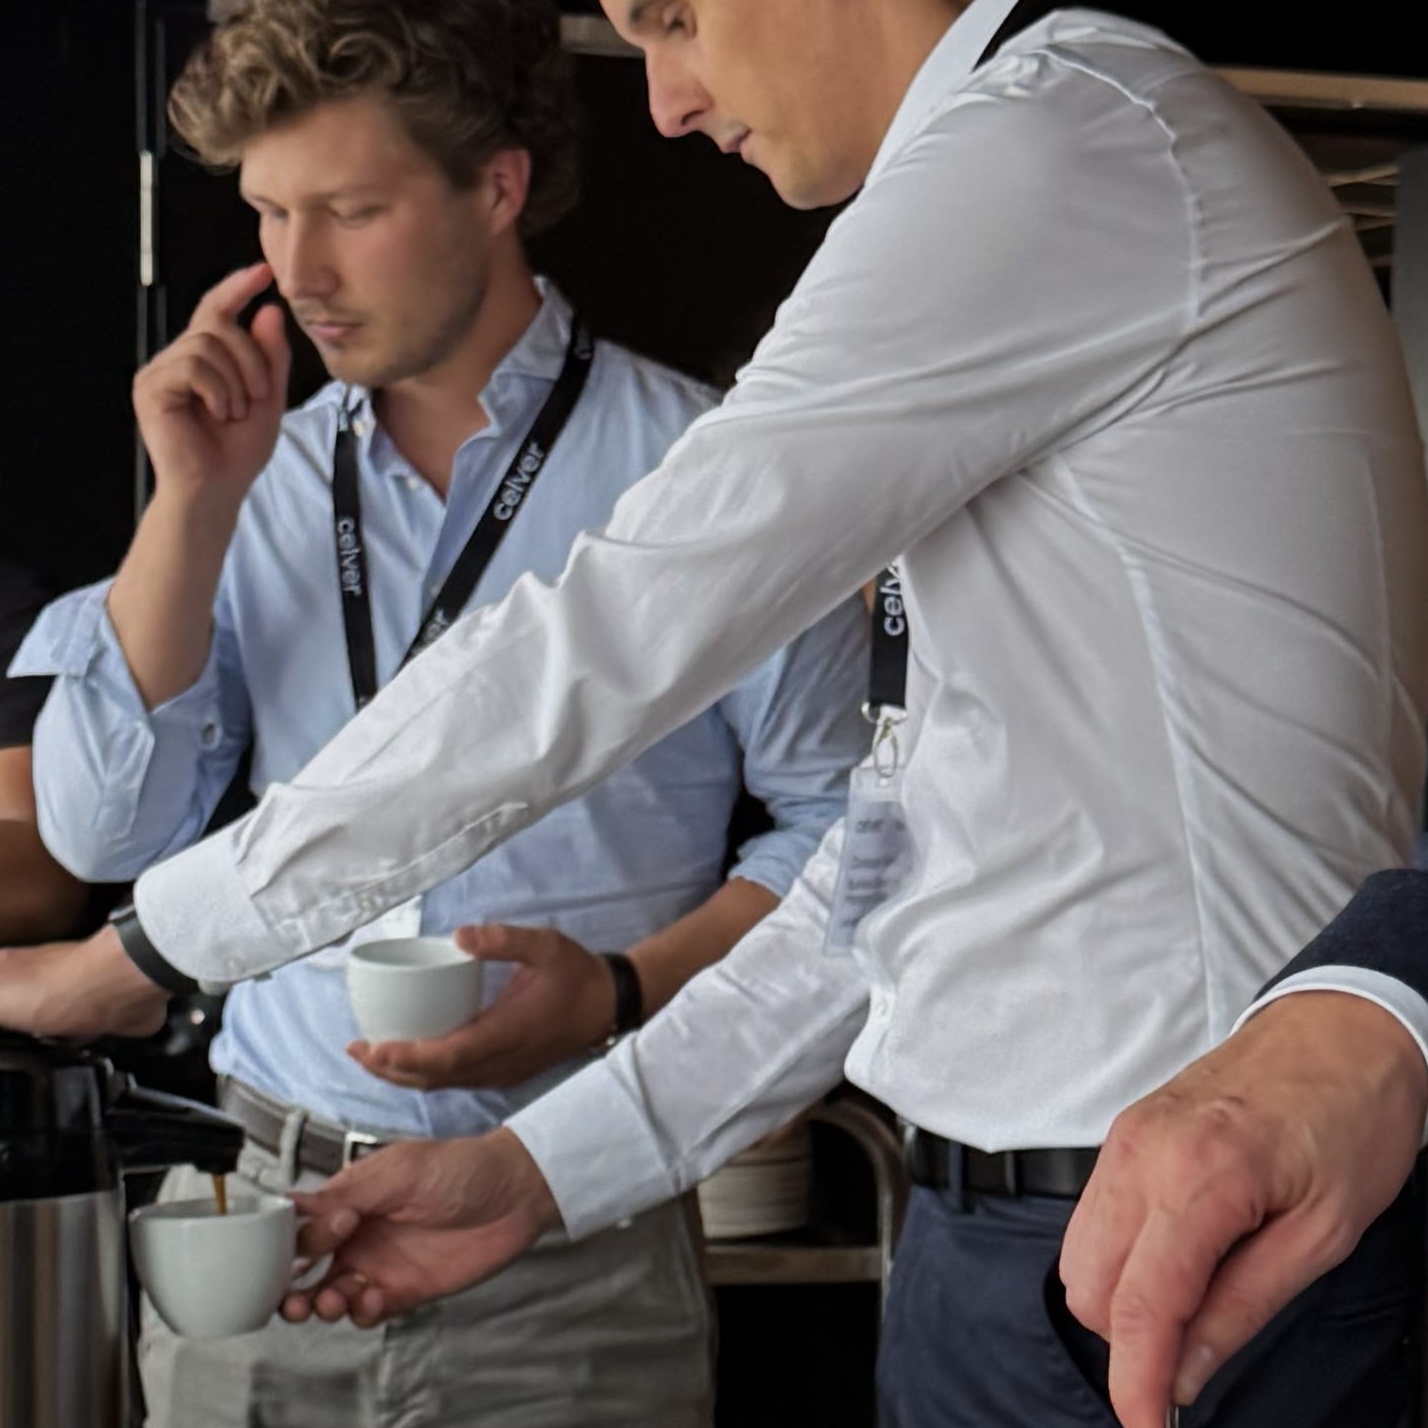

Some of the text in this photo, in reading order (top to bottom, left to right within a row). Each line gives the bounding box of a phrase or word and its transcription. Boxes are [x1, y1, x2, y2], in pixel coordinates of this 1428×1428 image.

[493, 443, 544, 521] celver
[337, 517, 362, 596] celver
[880, 565, 905, 636] celv
